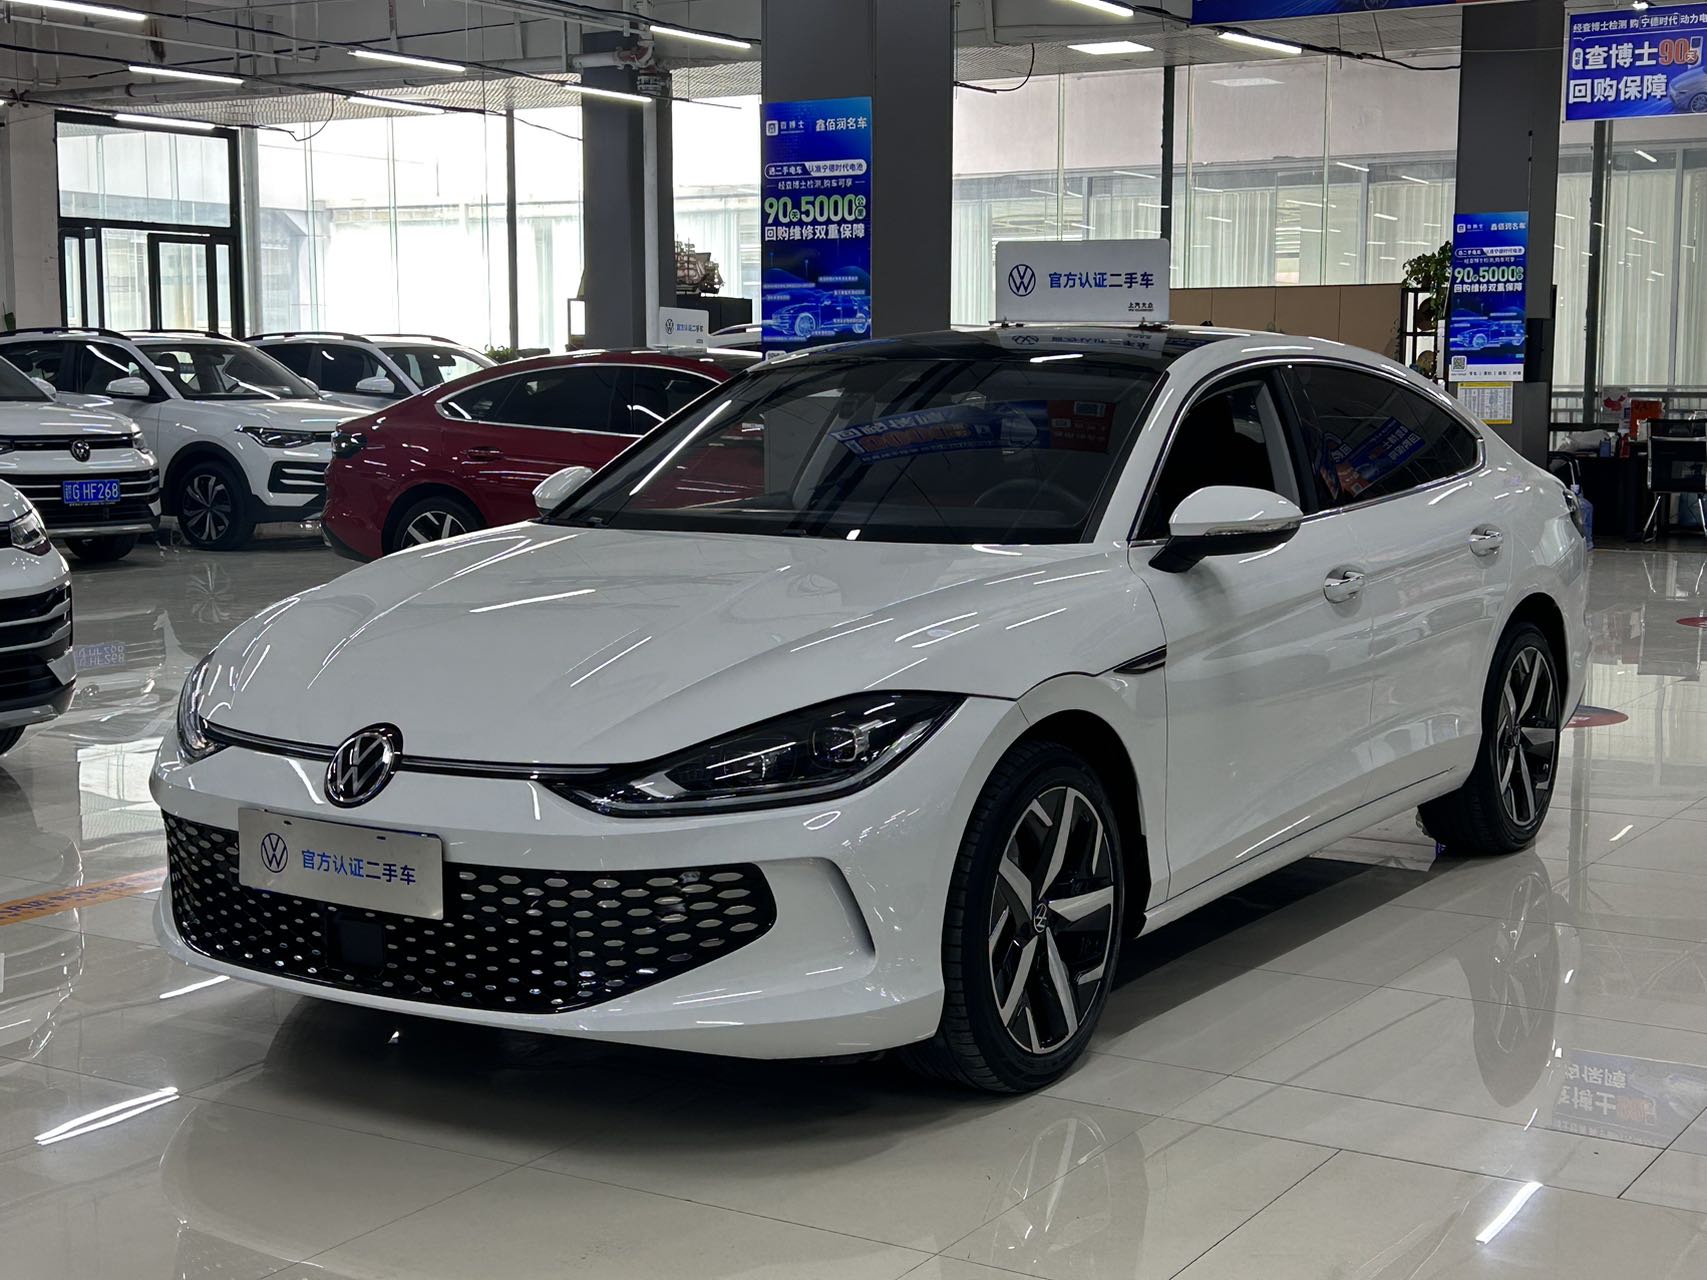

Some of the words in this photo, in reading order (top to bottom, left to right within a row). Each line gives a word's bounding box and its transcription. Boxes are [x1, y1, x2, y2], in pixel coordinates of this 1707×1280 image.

[1569, 73, 1667, 104] 回购保障
[765, 224, 865, 241] 回购维修双重保障
[1049, 272, 1154, 289] 官方认证二手车
[83, 483, 118, 499] HF268
[302, 850, 416, 885] 官方认证二手车
